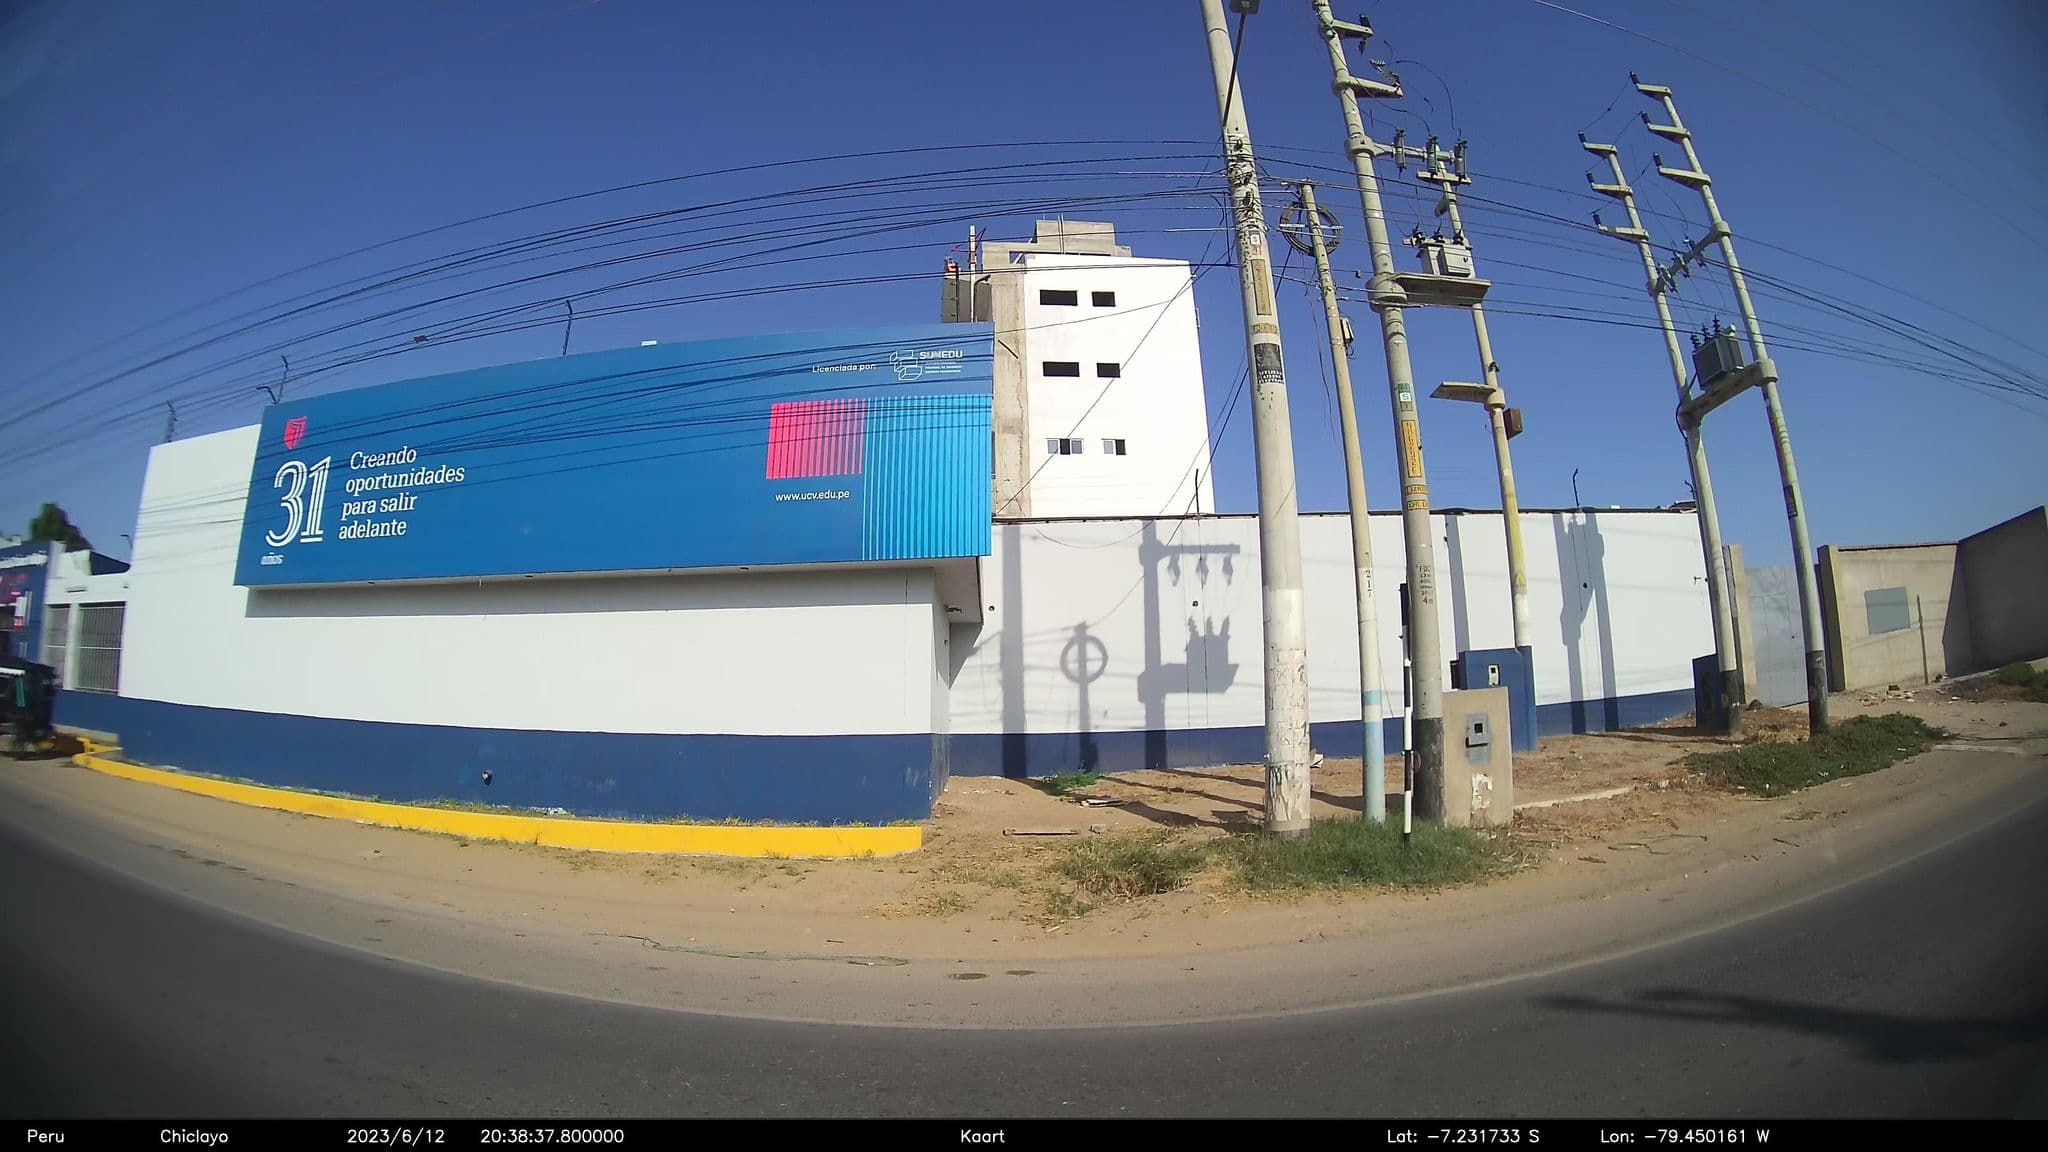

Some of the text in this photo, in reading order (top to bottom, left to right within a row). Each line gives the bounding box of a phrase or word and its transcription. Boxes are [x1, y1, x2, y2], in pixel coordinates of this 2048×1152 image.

[859, 363, 877, 372] por:
[350, 446, 417, 470] Creando
[345, 464, 465, 496] oportunidades
[265, 456, 332, 547] 31
[340, 492, 418, 521] para salir
[775, 489, 850, 502] www.ucv.edu.pe
[338, 519, 407, 540] adelante
